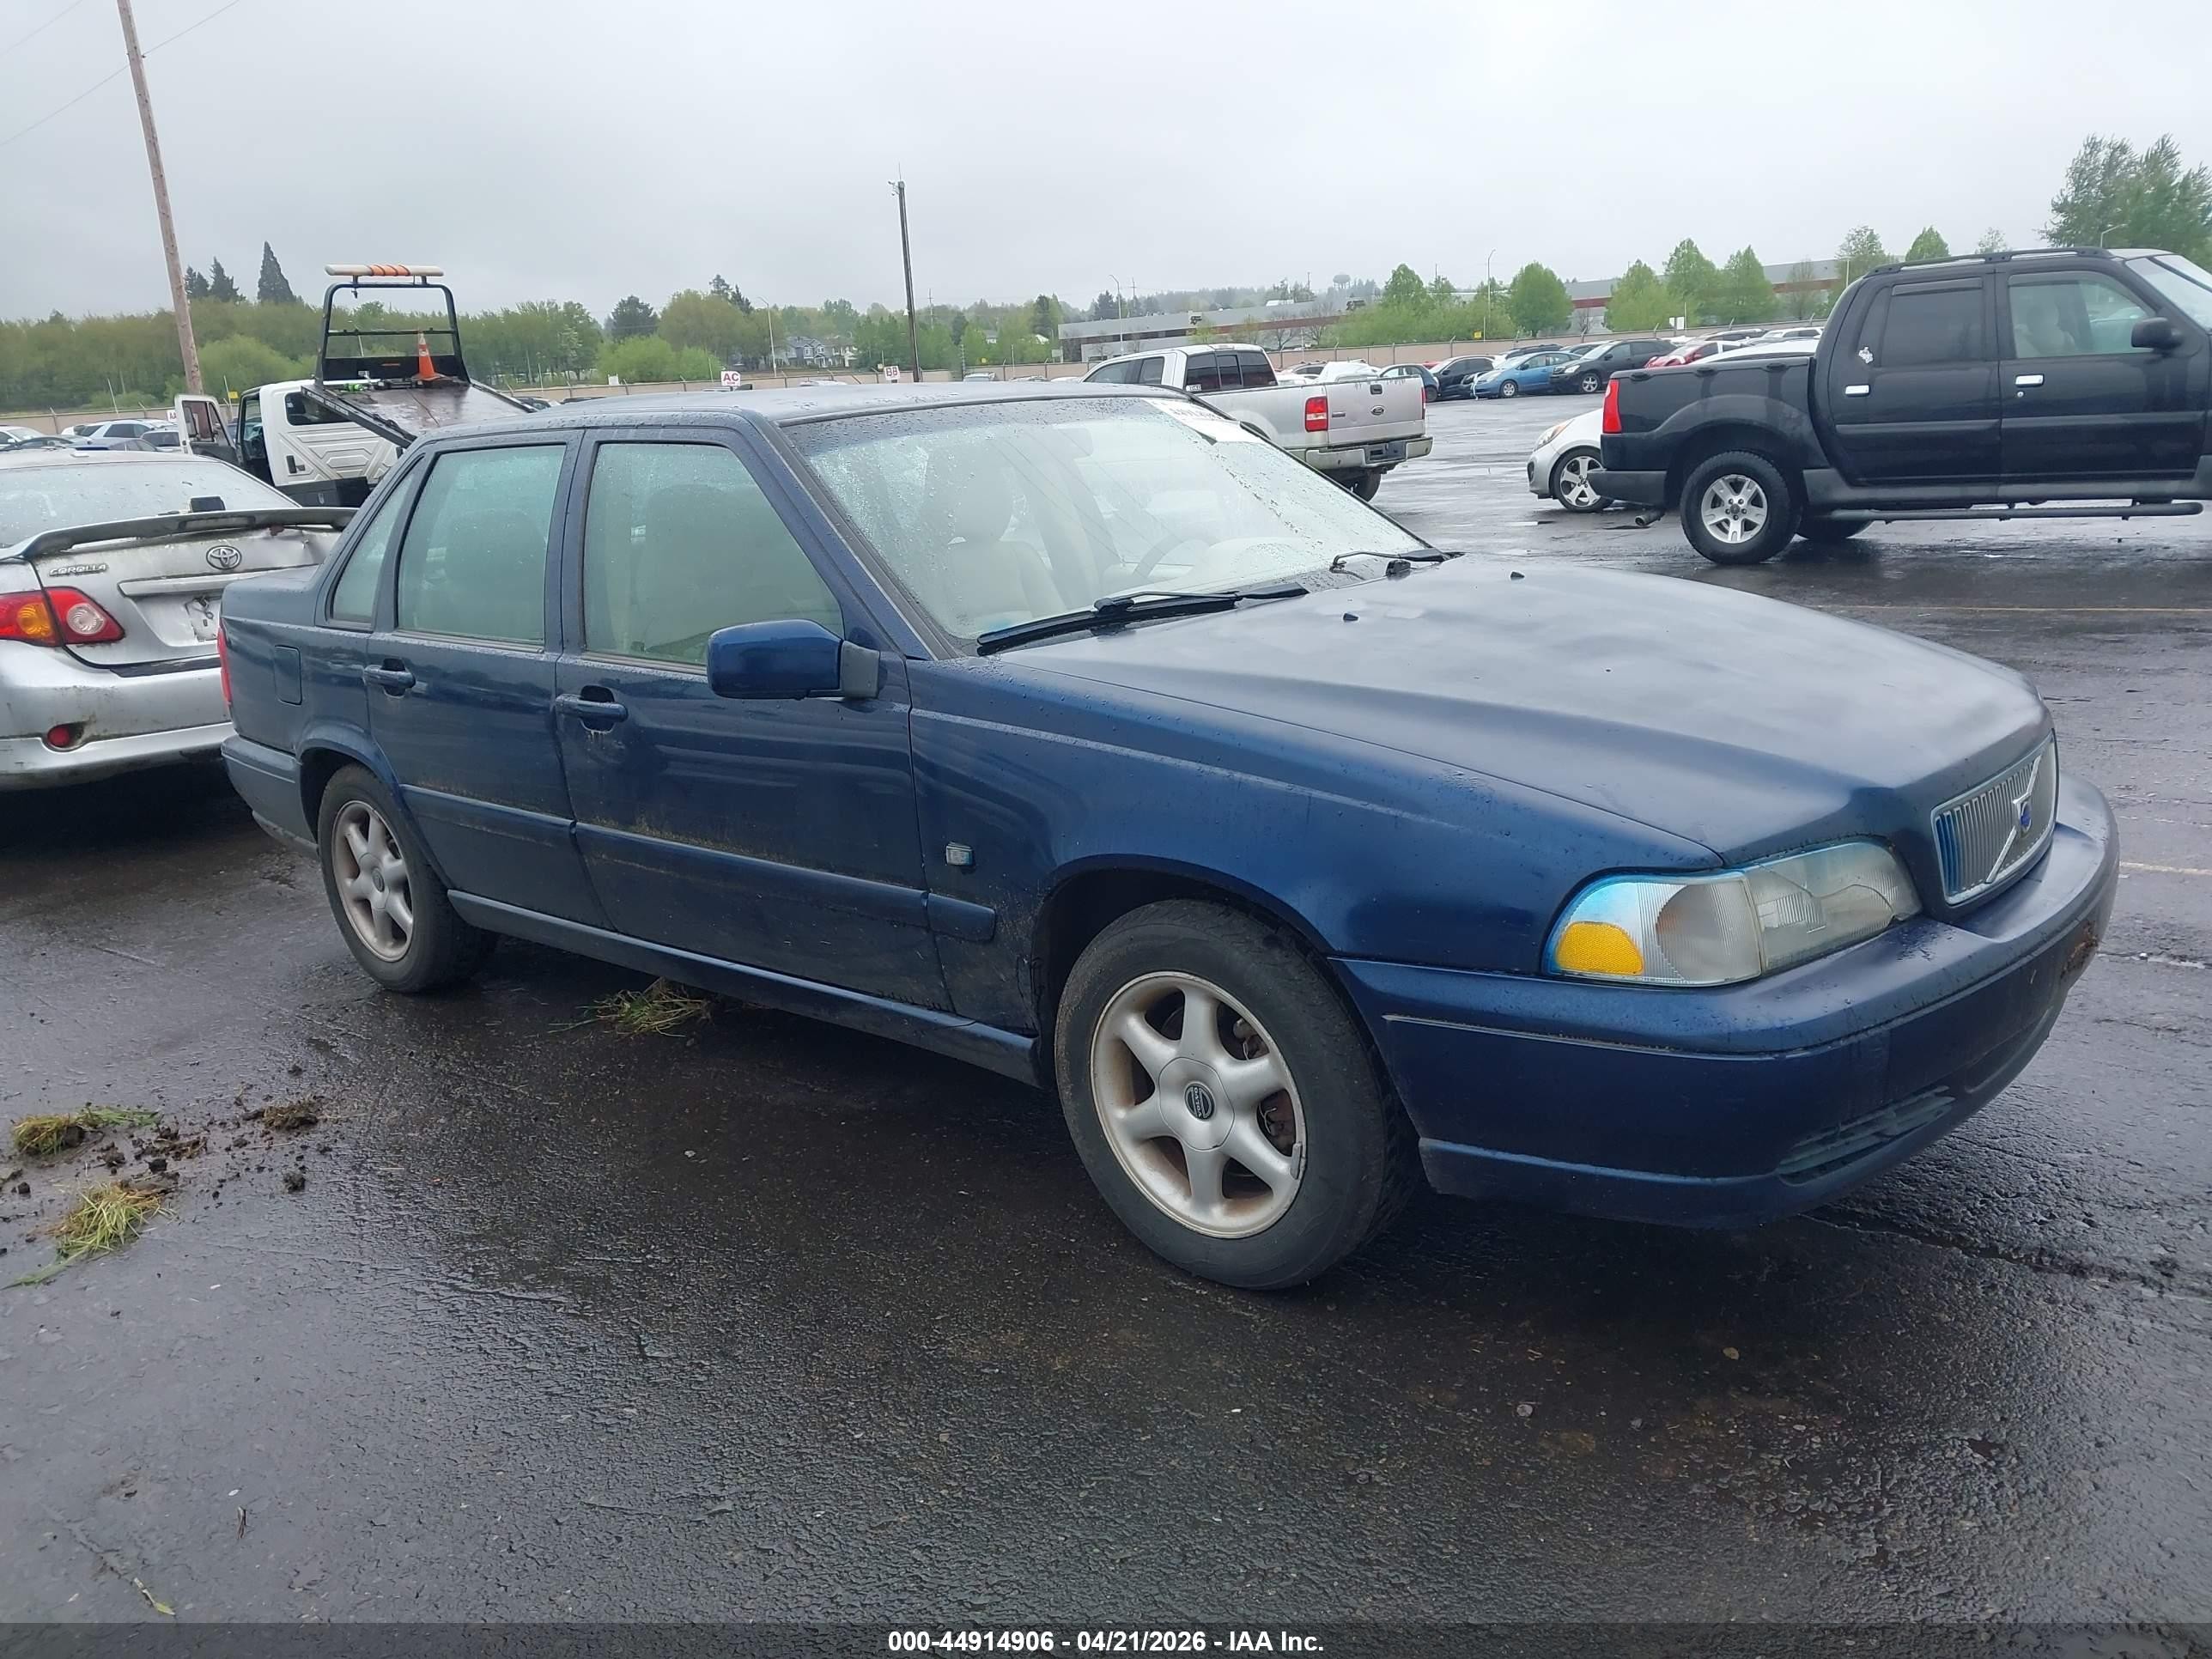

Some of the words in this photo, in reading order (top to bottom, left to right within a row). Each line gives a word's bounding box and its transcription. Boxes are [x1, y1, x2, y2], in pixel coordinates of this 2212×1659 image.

[886, 367, 898, 376] BB
[723, 373, 739, 381] AC
[49, 563, 108, 575] COROLLA
[1194, 1086, 1202, 1118] VOLVO
